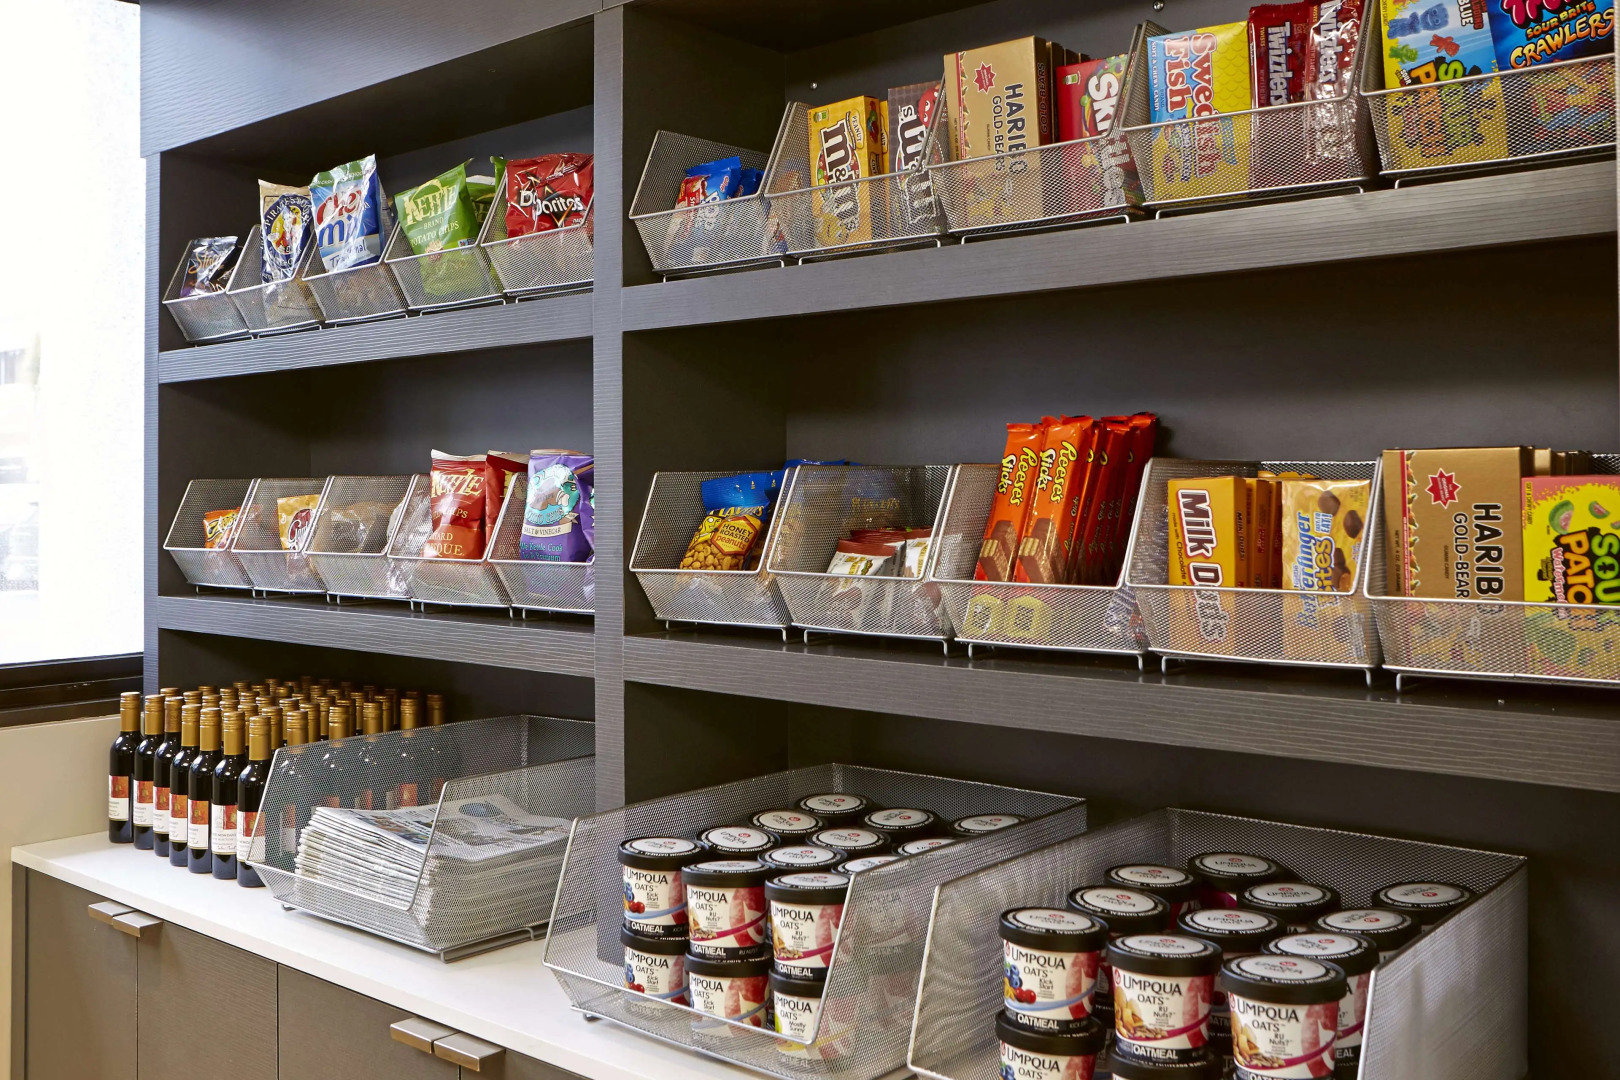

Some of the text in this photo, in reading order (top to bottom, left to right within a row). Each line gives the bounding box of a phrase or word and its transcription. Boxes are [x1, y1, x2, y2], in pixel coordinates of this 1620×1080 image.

[1526, 17, 1559, 39] SOUR
[1559, 1, 1596, 21] BRITE
[1510, 8, 1615, 69] CRAWLERS
[1267, 21, 1294, 106] Twizzlers
[1164, 36, 1192, 113] Fish
[851, 115, 862, 142] PEANUT
[1003, 83, 1028, 174] HARIBO
[402, 179, 457, 226] KETTLE
[423, 216, 444, 230] BRAND
[438, 221, 460, 240] CHIPS
[997, 454, 1017, 494] Sticks
[1009, 446, 1038, 506] Reese's
[1037, 448, 1056, 491] Sticks
[1050, 440, 1078, 504] Reese's
[722, 523, 753, 537] HONEY
[1179, 489, 1216, 556] Milk
[1320, 513, 1333, 533] EAT!
[540, 527, 562, 536] VINEGAR
[719, 529, 750, 543] ROASTED
[716, 535, 747, 551] peanuts
[1177, 541, 1187, 580] Chocolate
[1453, 512, 1471, 607] GOLD-BEAR
[626, 866, 669, 885] UMPQUA
[634, 882, 654, 892] OATS
[695, 902, 714, 912] OATS
[631, 921, 664, 933] OATMEAL
[779, 920, 800, 931] OATS
[628, 947, 669, 969] UMPQUA
[694, 944, 726, 956] OATMEAL
[1011, 946, 1066, 970] UMPQUA
[635, 964, 655, 976] OATS
[779, 964, 813, 976] OATMEAL
[1023, 966, 1049, 979] OATS
[1123, 974, 1183, 996] UMPQUA
[693, 988, 711, 1000] OATS
[1137, 993, 1164, 1006] OATS
[780, 1010, 798, 1021] OATS
[1237, 998, 1300, 1023] UMPQUA
[788, 1020, 807, 1029] Mostly
[789, 1026, 806, 1034] Sunny
[1017, 1013, 1060, 1030] OATMEAL
[1252, 1020, 1280, 1033] OATS
[1274, 1032, 1285, 1040] RU
[1006, 1046, 1061, 1073] UMPQUA
[1133, 1045, 1178, 1060] OATMEAL
[1018, 1066, 1044, 1080] OATS
